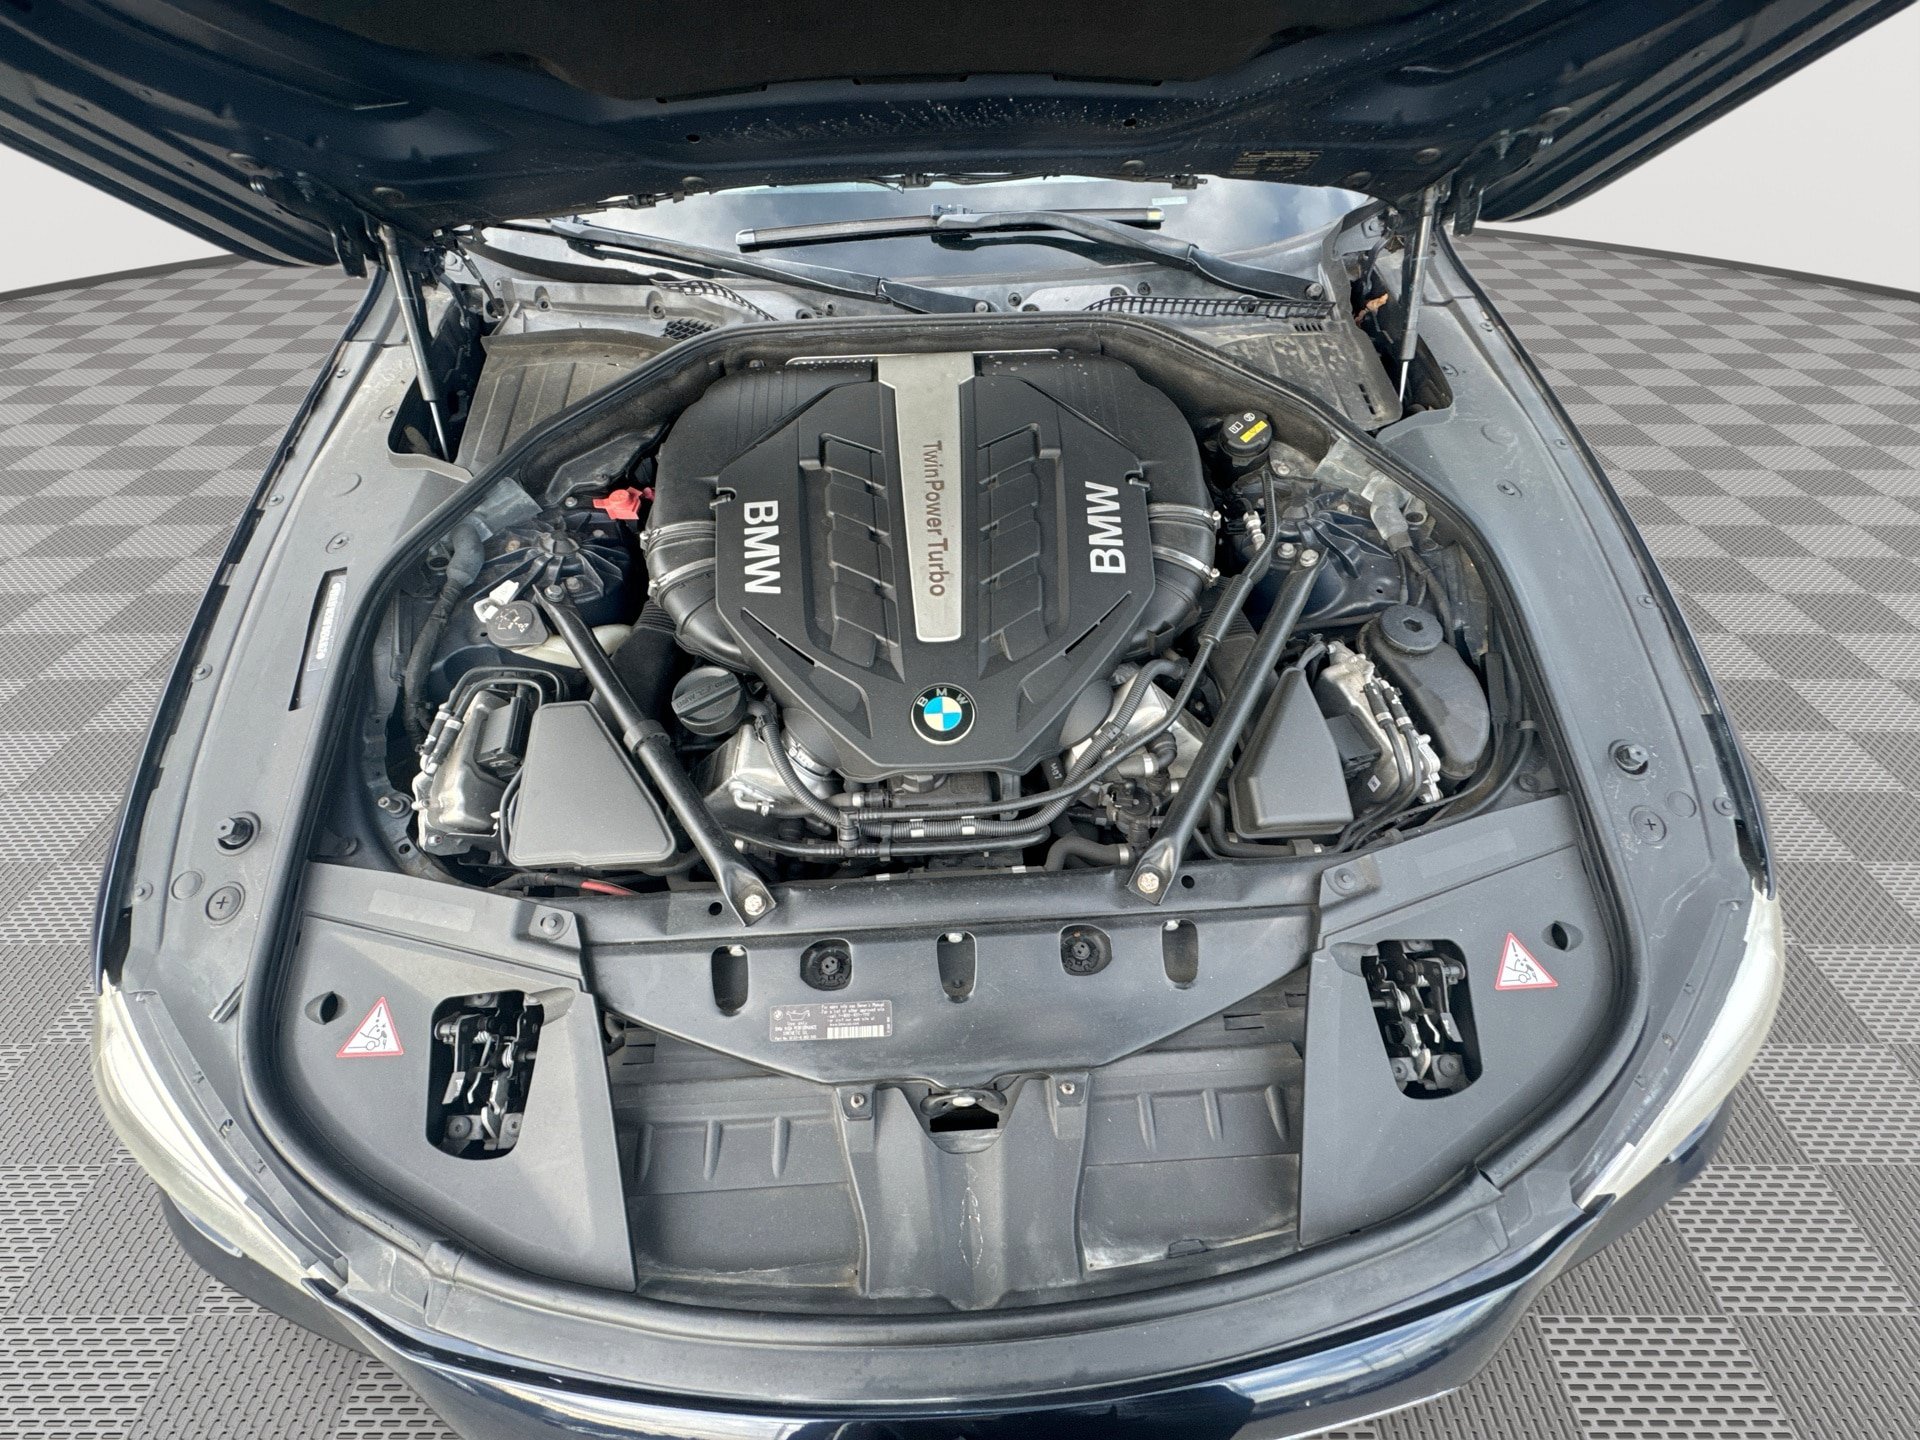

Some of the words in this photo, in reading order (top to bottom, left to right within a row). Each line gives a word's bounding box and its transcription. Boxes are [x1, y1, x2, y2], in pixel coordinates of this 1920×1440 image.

[923, 440, 945, 536] TwinPower
[1084, 481, 1126, 574] BMW
[743, 500, 781, 594] BMW
[928, 537, 950, 597] Turbo
[916, 687, 969, 708] BMW
